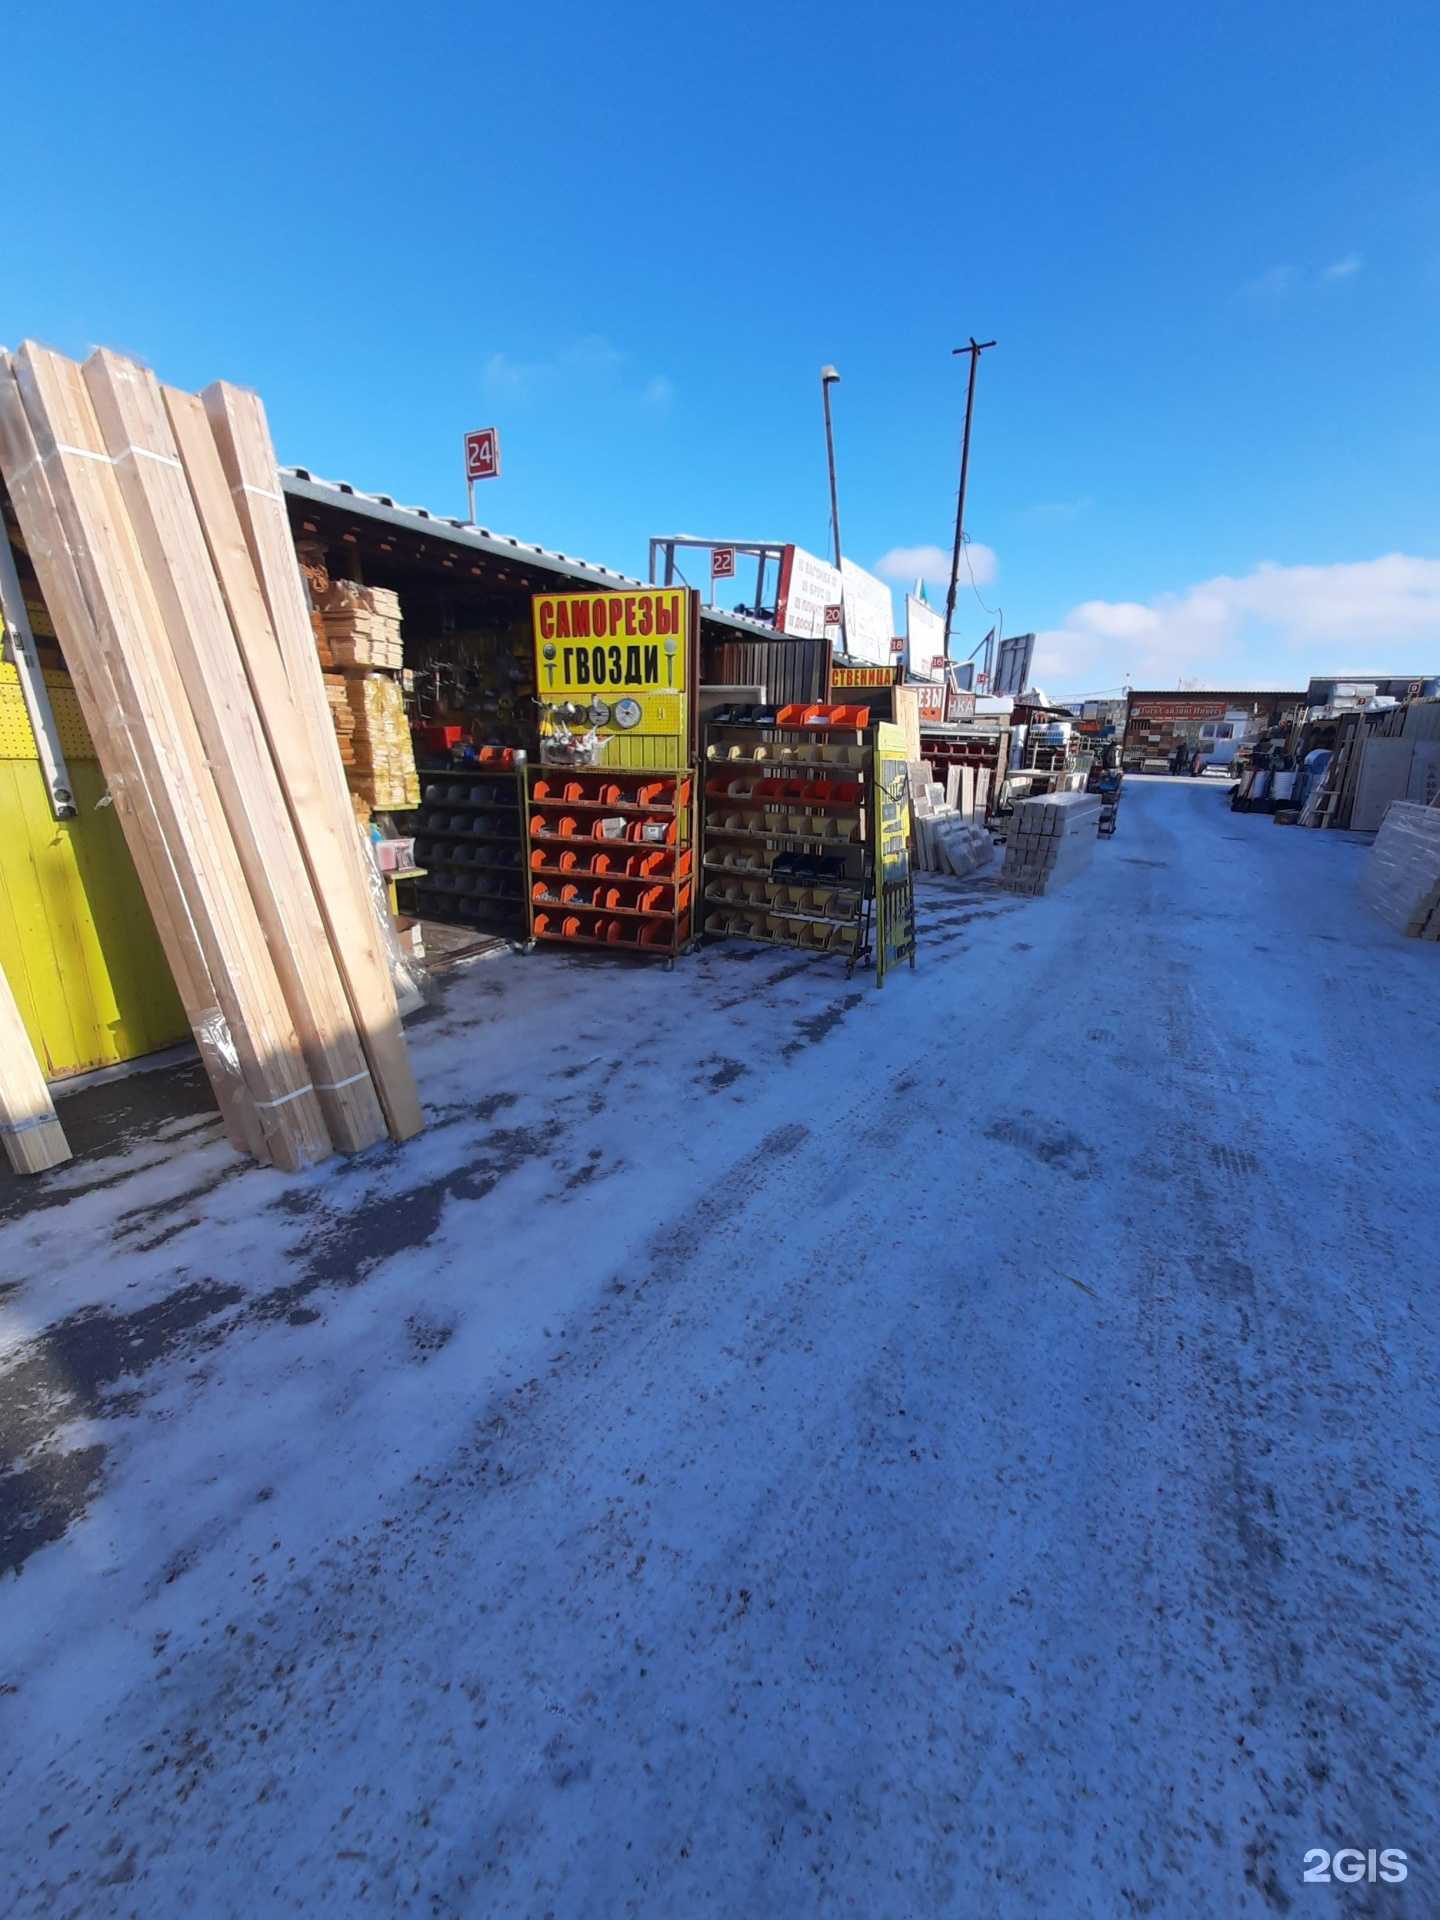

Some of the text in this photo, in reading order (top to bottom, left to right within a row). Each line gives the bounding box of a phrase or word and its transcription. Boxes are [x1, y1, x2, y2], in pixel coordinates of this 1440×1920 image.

[470, 441, 491, 466] 24
[715, 554, 730, 570] 22
[540, 595, 679, 640] САМОРЕЗЫ
[826, 608, 840, 621] 20
[892, 640, 903, 650] 18
[563, 645, 659, 685] ГВОЗДИ
